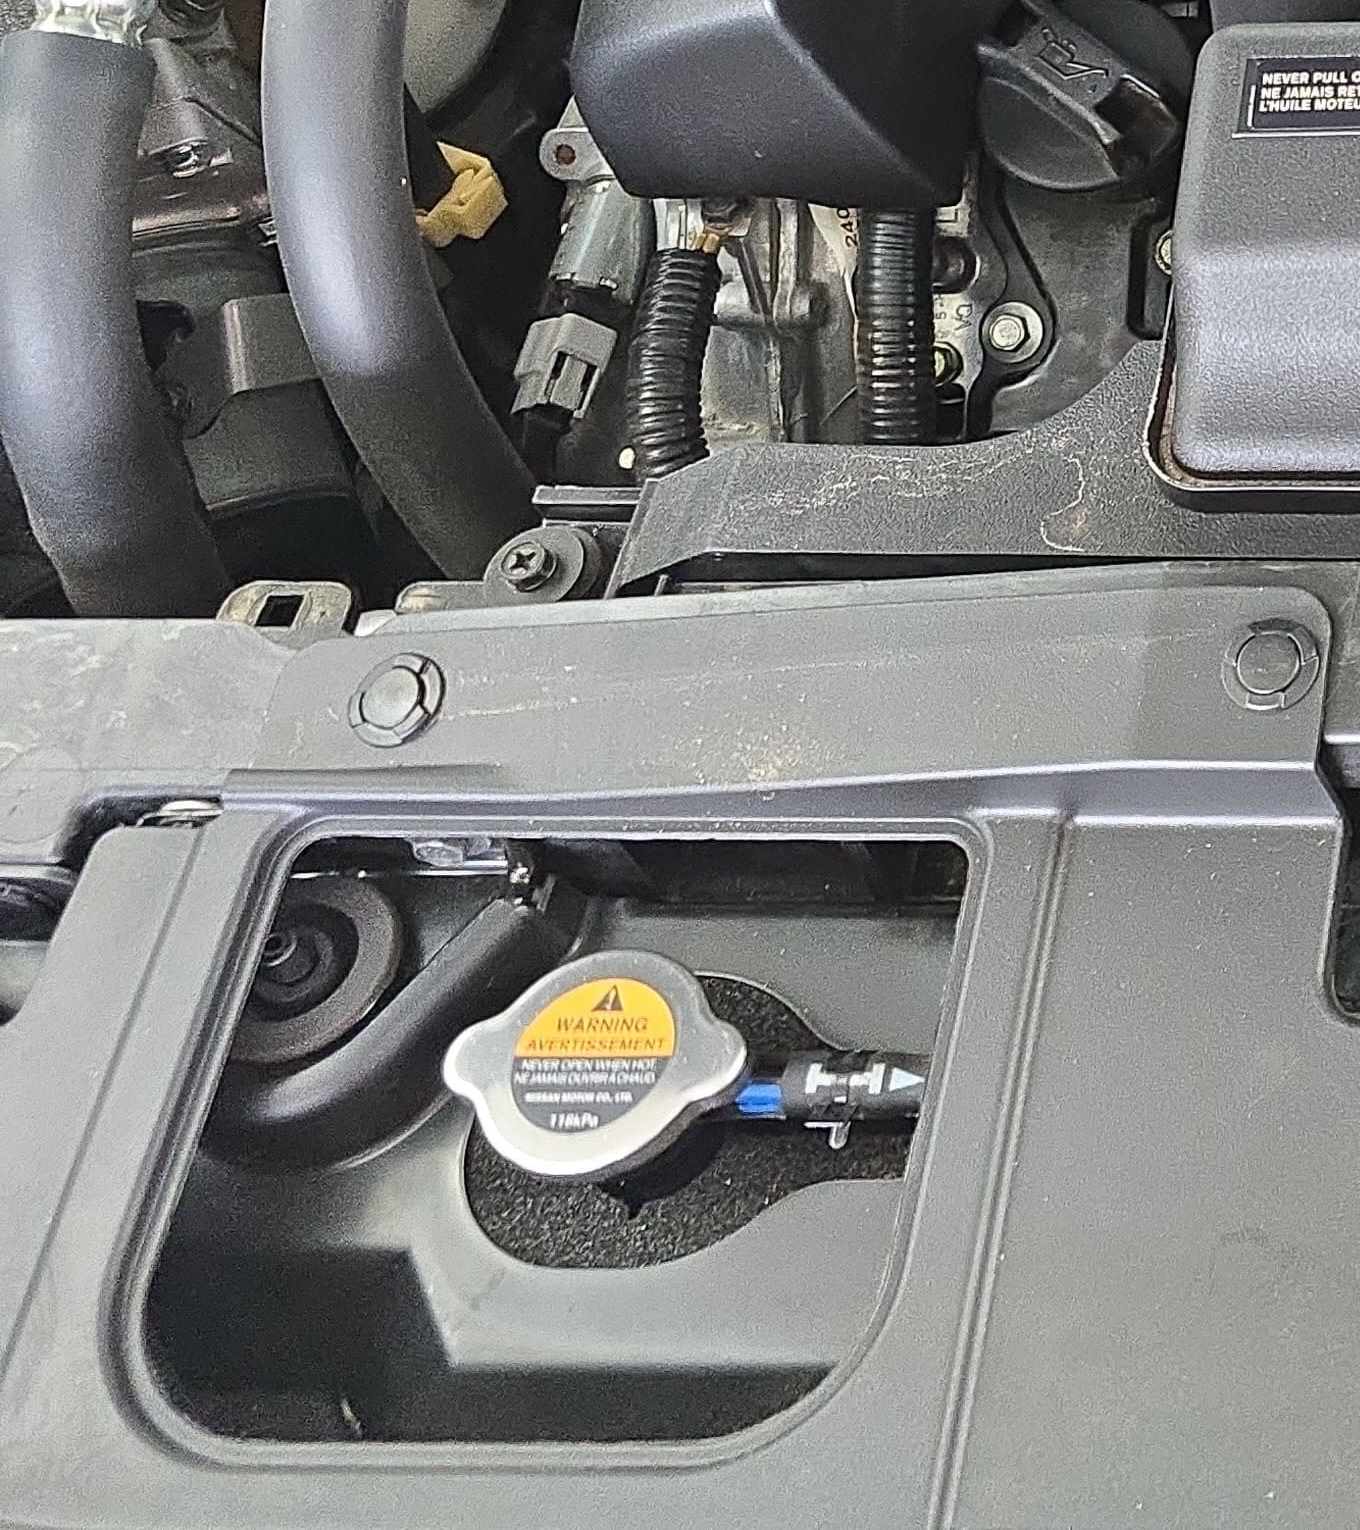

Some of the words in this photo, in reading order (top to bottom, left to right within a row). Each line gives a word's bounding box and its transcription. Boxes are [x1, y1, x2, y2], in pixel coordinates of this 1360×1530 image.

[1262, 72, 1310, 85] NEVER
[1312, 71, 1348, 84] PULL
[1261, 87, 1280, 99] NE
[1283, 86, 1334, 99] JAMAIS
[1259, 99, 1311, 112] L'HUILE
[557, 1017, 649, 1032] WARNING
[526, 1037, 666, 1052] AVERTISSEMENT
